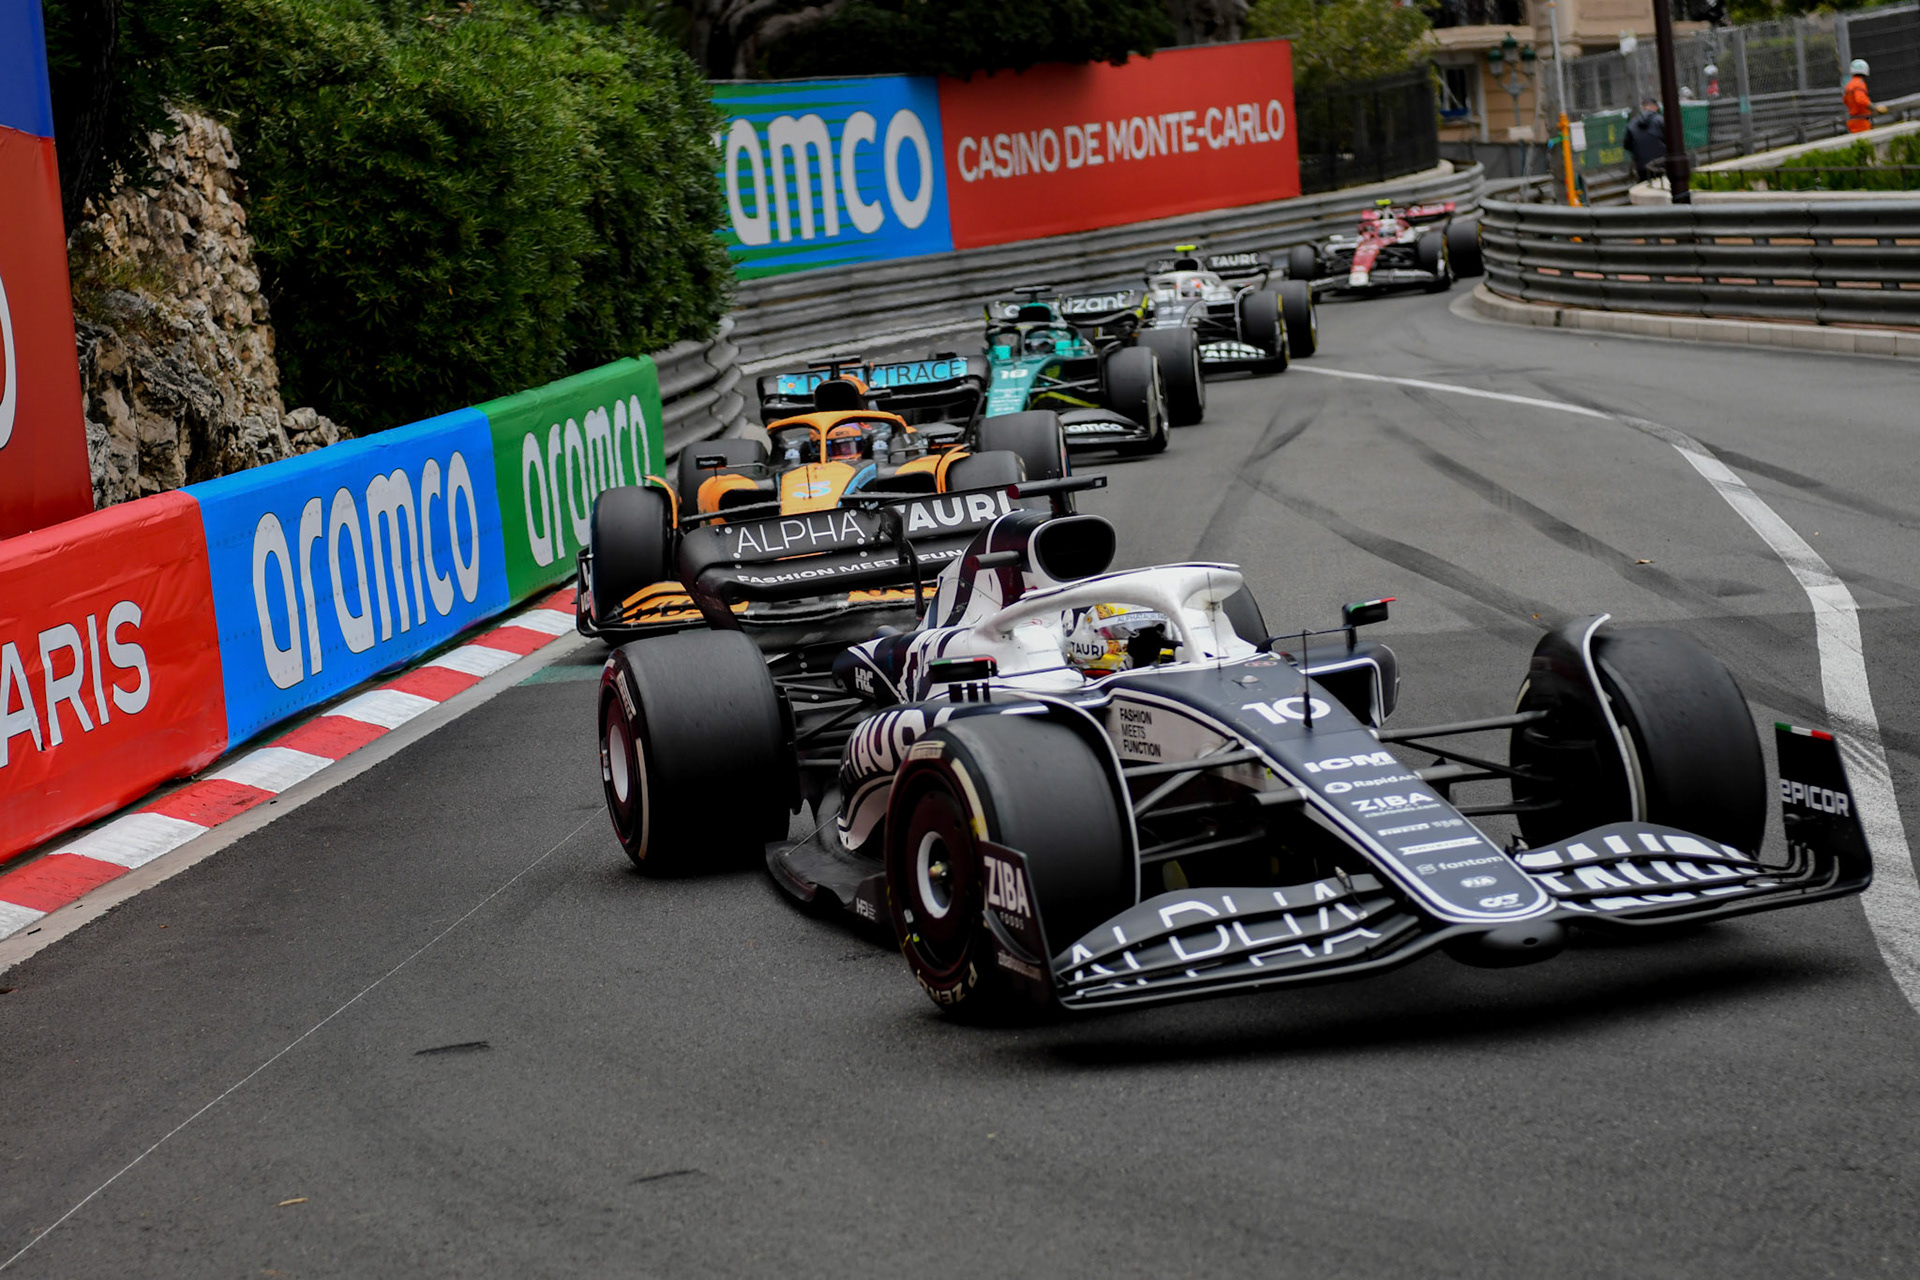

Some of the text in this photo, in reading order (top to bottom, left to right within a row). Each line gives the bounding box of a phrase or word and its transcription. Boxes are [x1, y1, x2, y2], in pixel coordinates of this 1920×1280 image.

[957, 99, 1286, 183] CASINO DE MONTE-CARLO
[715, 108, 933, 246] amco
[1210, 252, 1259, 268] TAURI
[1000, 369, 1029, 380] 18
[1064, 422, 1124, 434] amco
[522, 393, 652, 568] aramco
[792, 480, 832, 499] 3
[737, 511, 866, 556] ALPHA
[252, 450, 480, 691] aramco
[736, 566, 836, 585] FASHION
[838, 557, 900, 574] MEET
[1071, 641, 1105, 660] TAURI
[1120, 707, 1153, 725] FASHION
[1241, 697, 1332, 725] 10
[1122, 723, 1147, 740] MEETS
[1123, 739, 1162, 758] FUNCTION
[1303, 751, 1397, 773] ICM
[1351, 792, 1434, 812] ZIBA
[1438, 854, 1504, 871] fantom
[984, 855, 1032, 919] ZIBA
[999, 910, 1025, 931] FOODS
